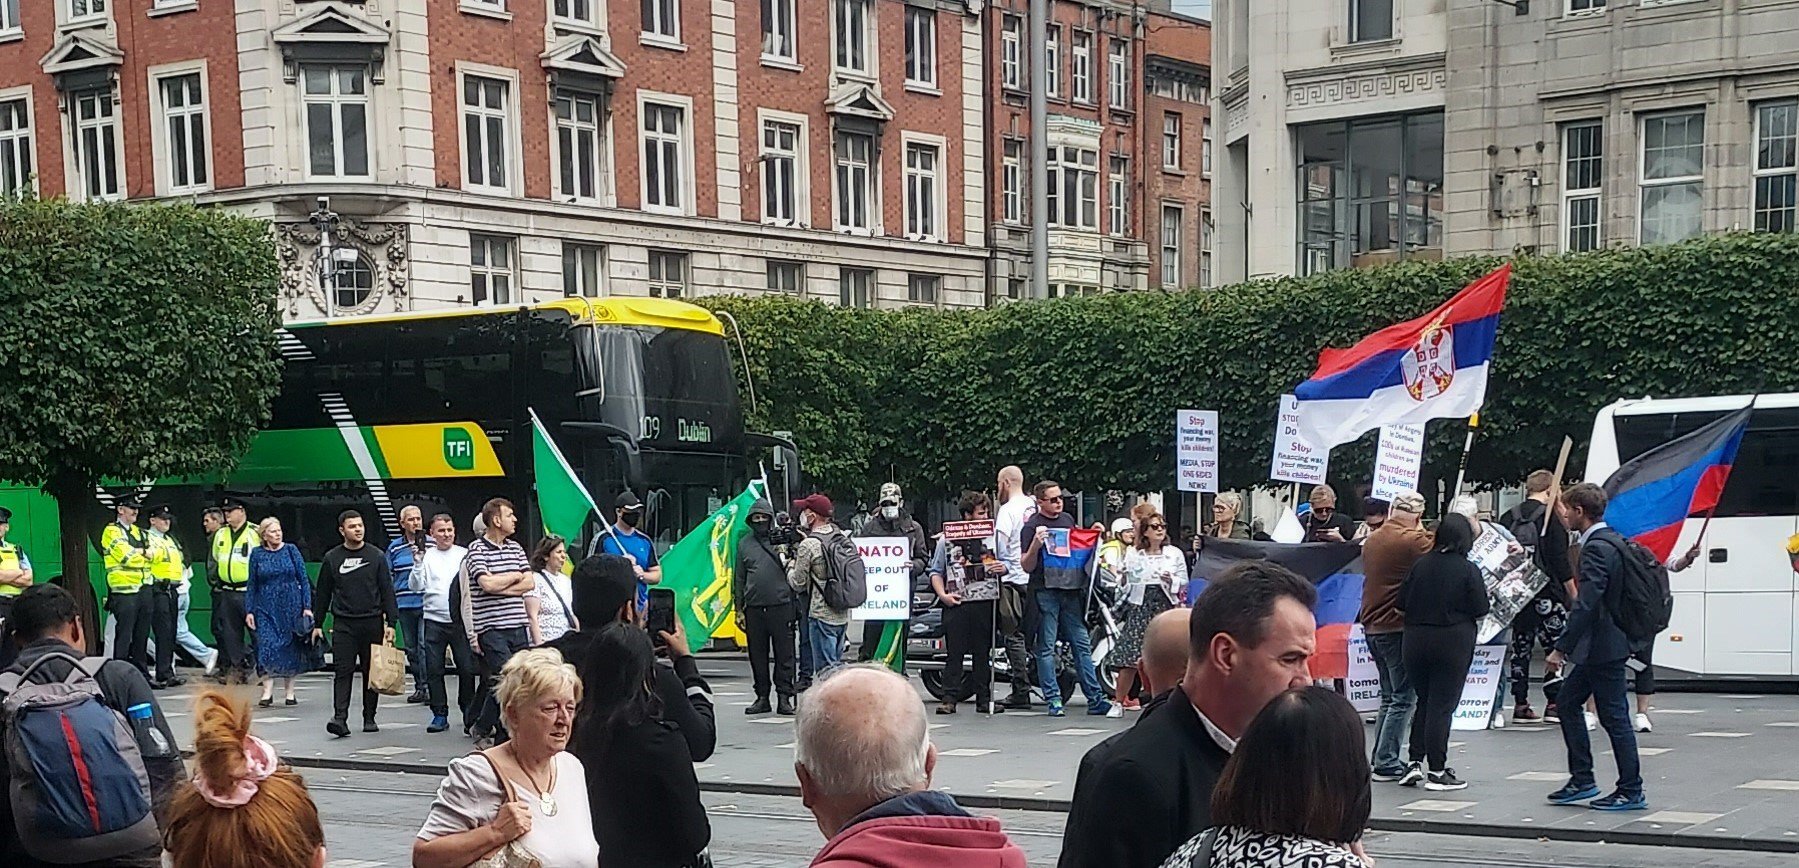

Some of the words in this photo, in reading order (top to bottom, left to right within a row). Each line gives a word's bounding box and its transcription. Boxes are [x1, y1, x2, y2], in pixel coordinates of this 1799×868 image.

[1189, 416, 1205, 427] Stop
[639, 416, 660, 440] 109
[678, 418, 711, 443] Dublin
[446, 440, 471, 458] TFI
[1277, 452, 1309, 463] financing
[1201, 460, 1216, 468] STOP
[1297, 463, 1319, 472] money
[1379, 463, 1416, 479] murdered
[1379, 473, 1387, 484] by
[1388, 475, 1414, 490] Ukraine
[858, 545, 904, 557] NATO
[863, 566, 882, 575] EEP
[884, 566, 905, 574] OUT
[874, 584, 889, 592] OF
[861, 600, 907, 609] RELAND
[1349, 678, 1379, 688] tomo
[1454, 710, 1489, 719] LAND?
